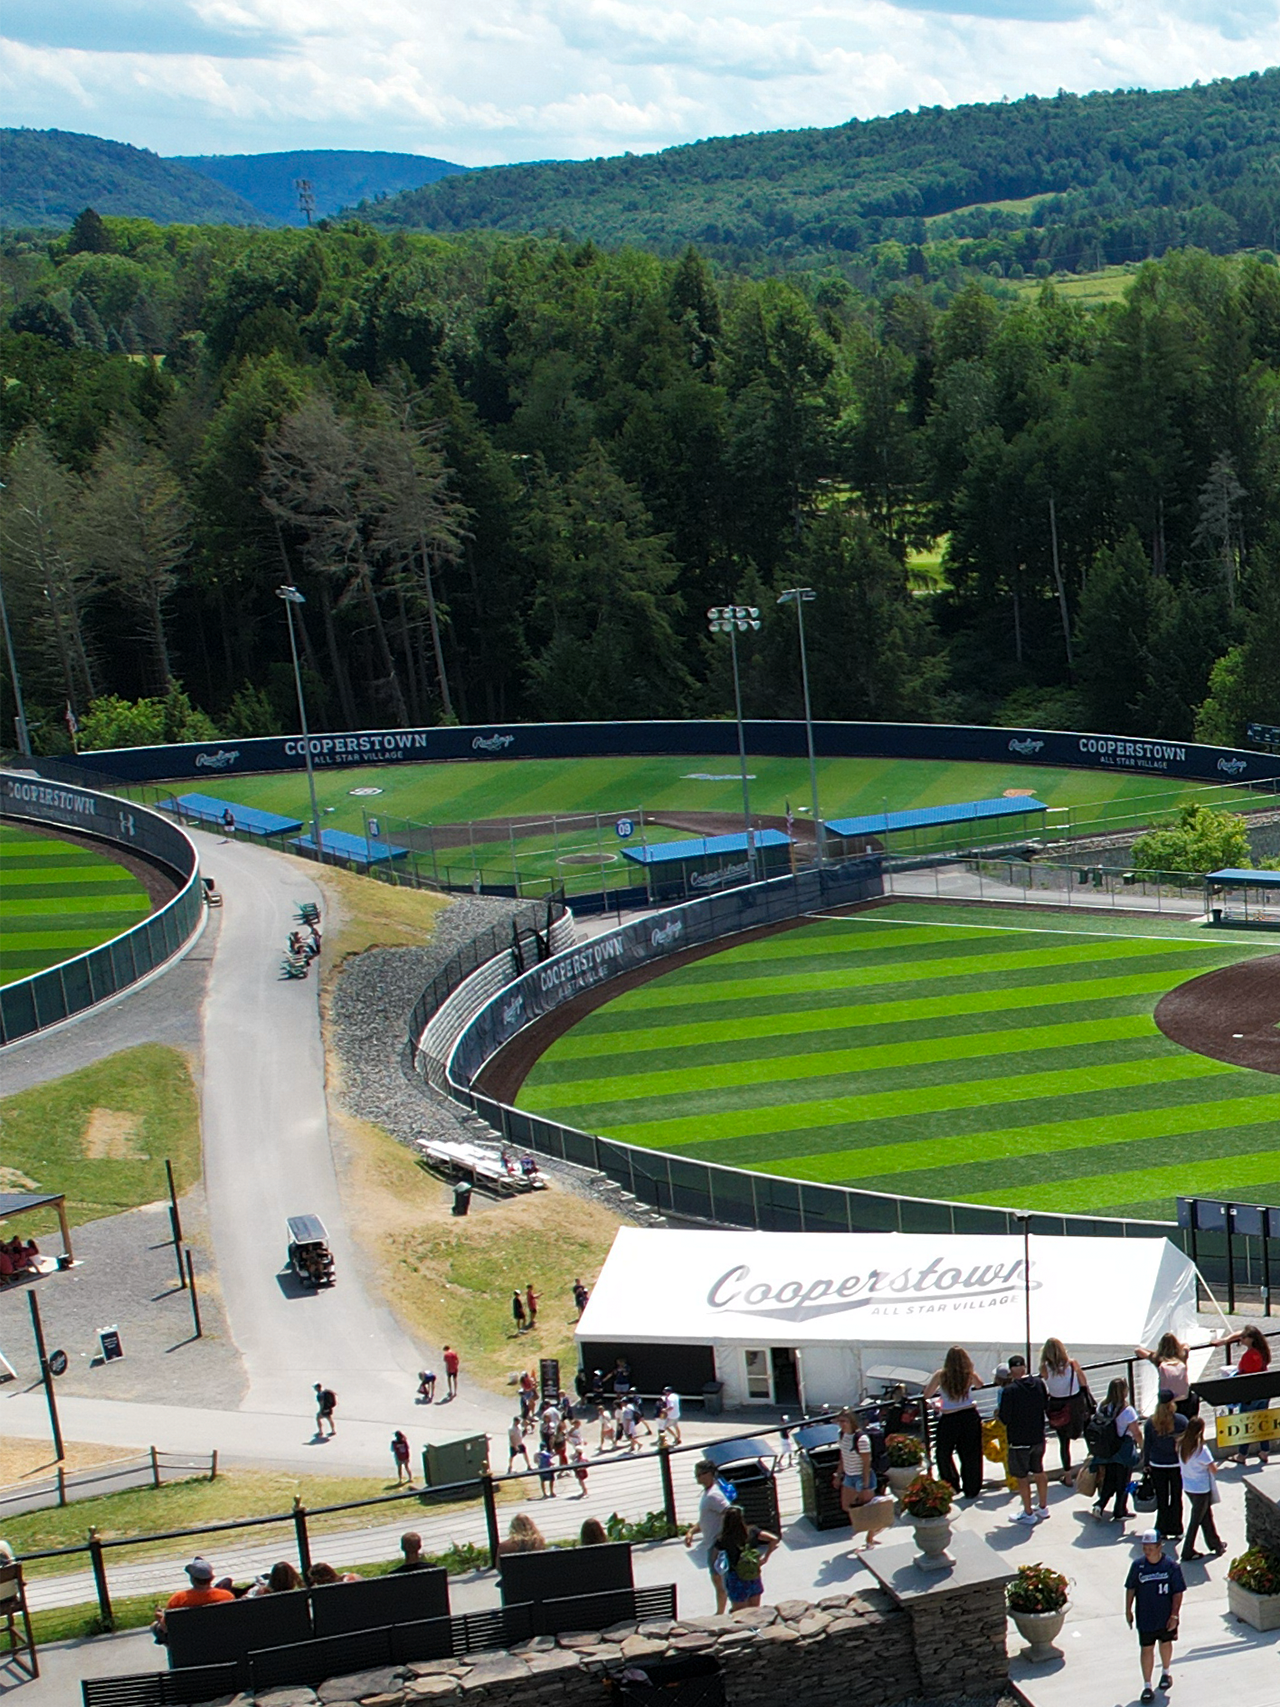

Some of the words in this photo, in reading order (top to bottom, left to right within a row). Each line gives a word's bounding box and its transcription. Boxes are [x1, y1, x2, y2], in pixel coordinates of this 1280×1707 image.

[285, 733, 428, 756] COOPERSTOWN
[1079, 738, 1187, 762] COOPERSTOWN
[313, 755, 332, 764] ALL
[335, 752, 360, 763] STAR
[362, 750, 404, 761] VILLAGE
[1100, 755, 1115, 765] ALL
[1116, 757, 1136, 767] STAR
[1137, 759, 1168, 770] VILLAGE
[618, 823, 631, 836] 09
[540, 936, 624, 991] COOPERSTOWN
[706, 1256, 1040, 1310] Cooperstown
[871, 1307, 900, 1316] ALL
[905, 1303, 947, 1315] STAR
[953, 1294, 1020, 1312] VILLAGE
[1158, 1583, 1169, 1595] 14
